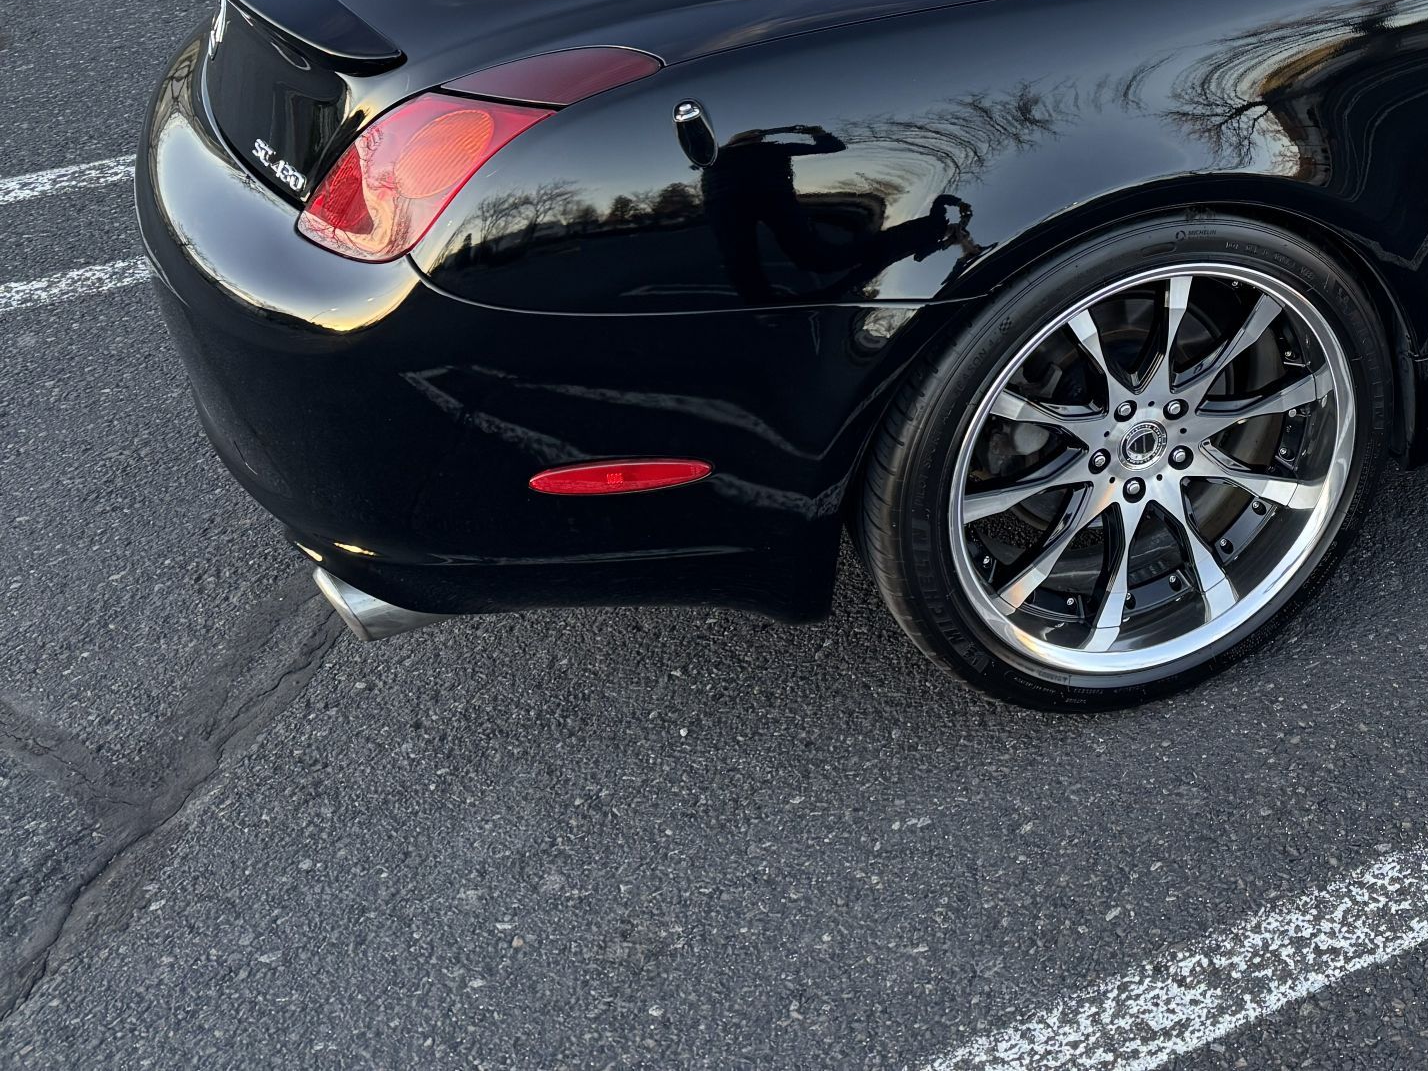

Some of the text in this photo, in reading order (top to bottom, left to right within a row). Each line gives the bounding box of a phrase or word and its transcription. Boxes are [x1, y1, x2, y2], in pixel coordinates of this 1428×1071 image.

[252, 138, 307, 191] SC 430
[911, 527, 970, 645] MICHELIN
